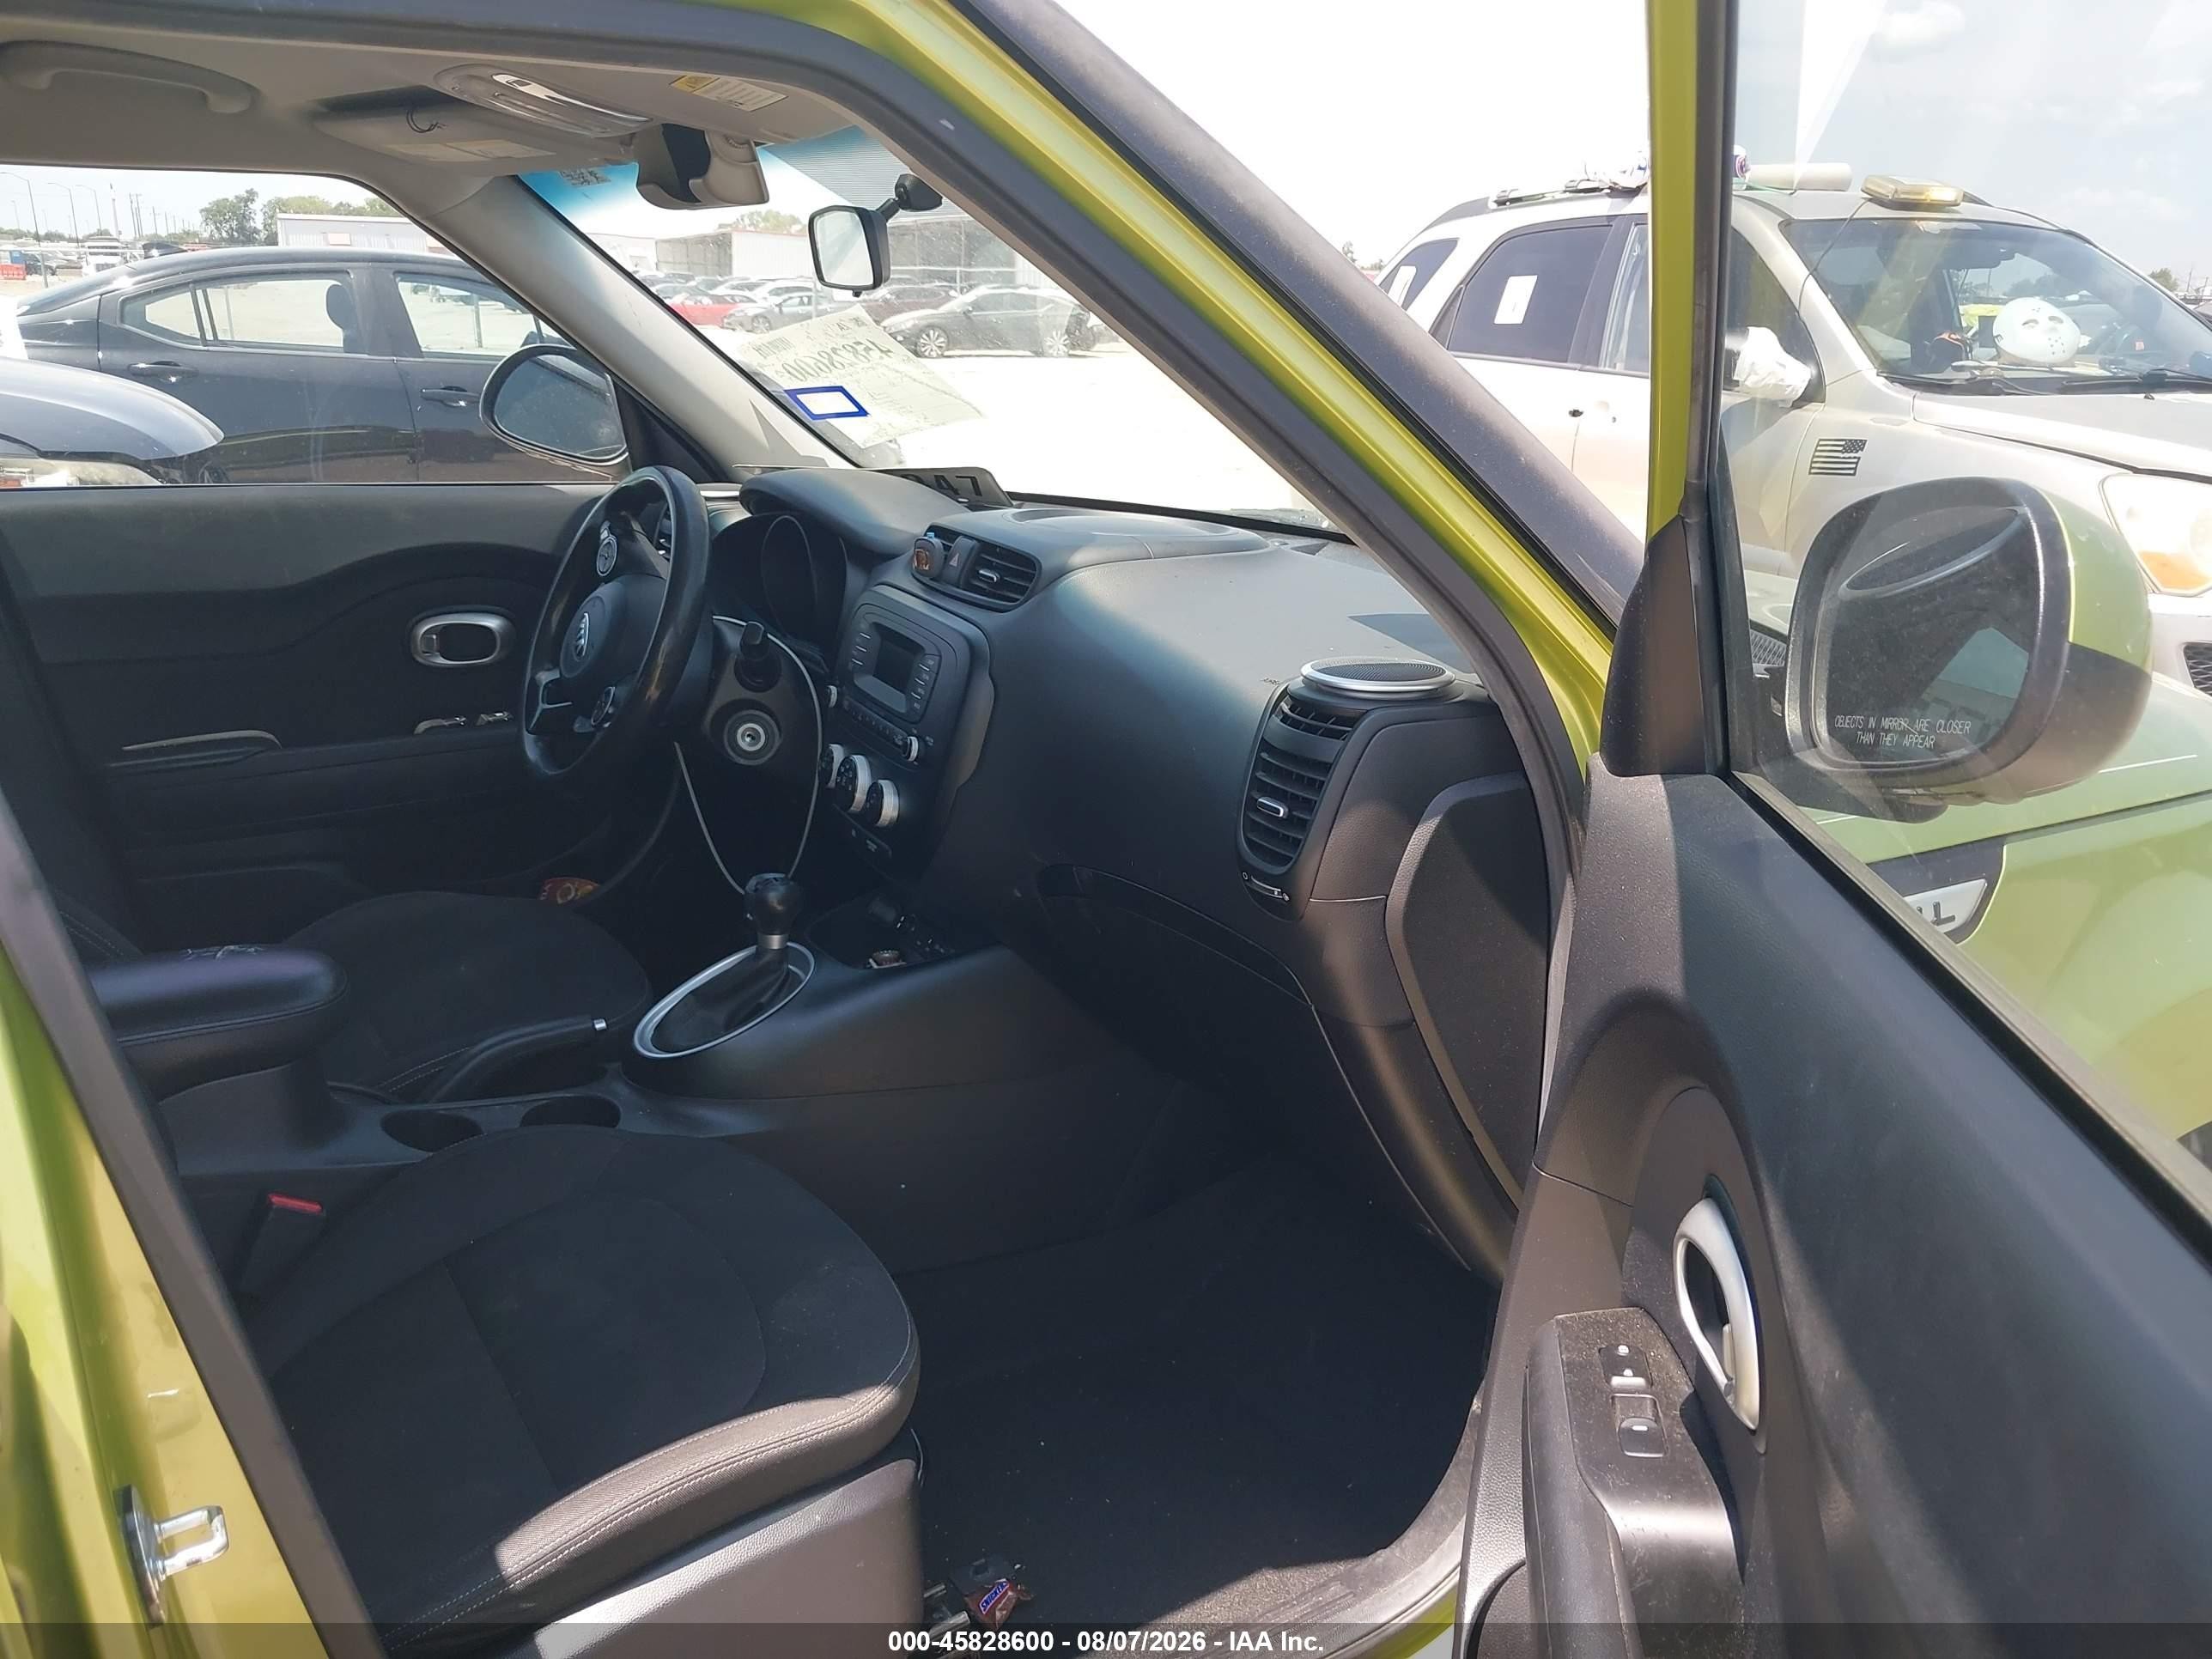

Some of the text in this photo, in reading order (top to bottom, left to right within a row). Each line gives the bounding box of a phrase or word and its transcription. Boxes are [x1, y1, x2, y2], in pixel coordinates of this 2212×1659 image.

[1834, 714, 1972, 735] OBJECTS IN MIRROR ARE CLOSER
[1856, 731, 1936, 749] THAN THEY APPEAR
